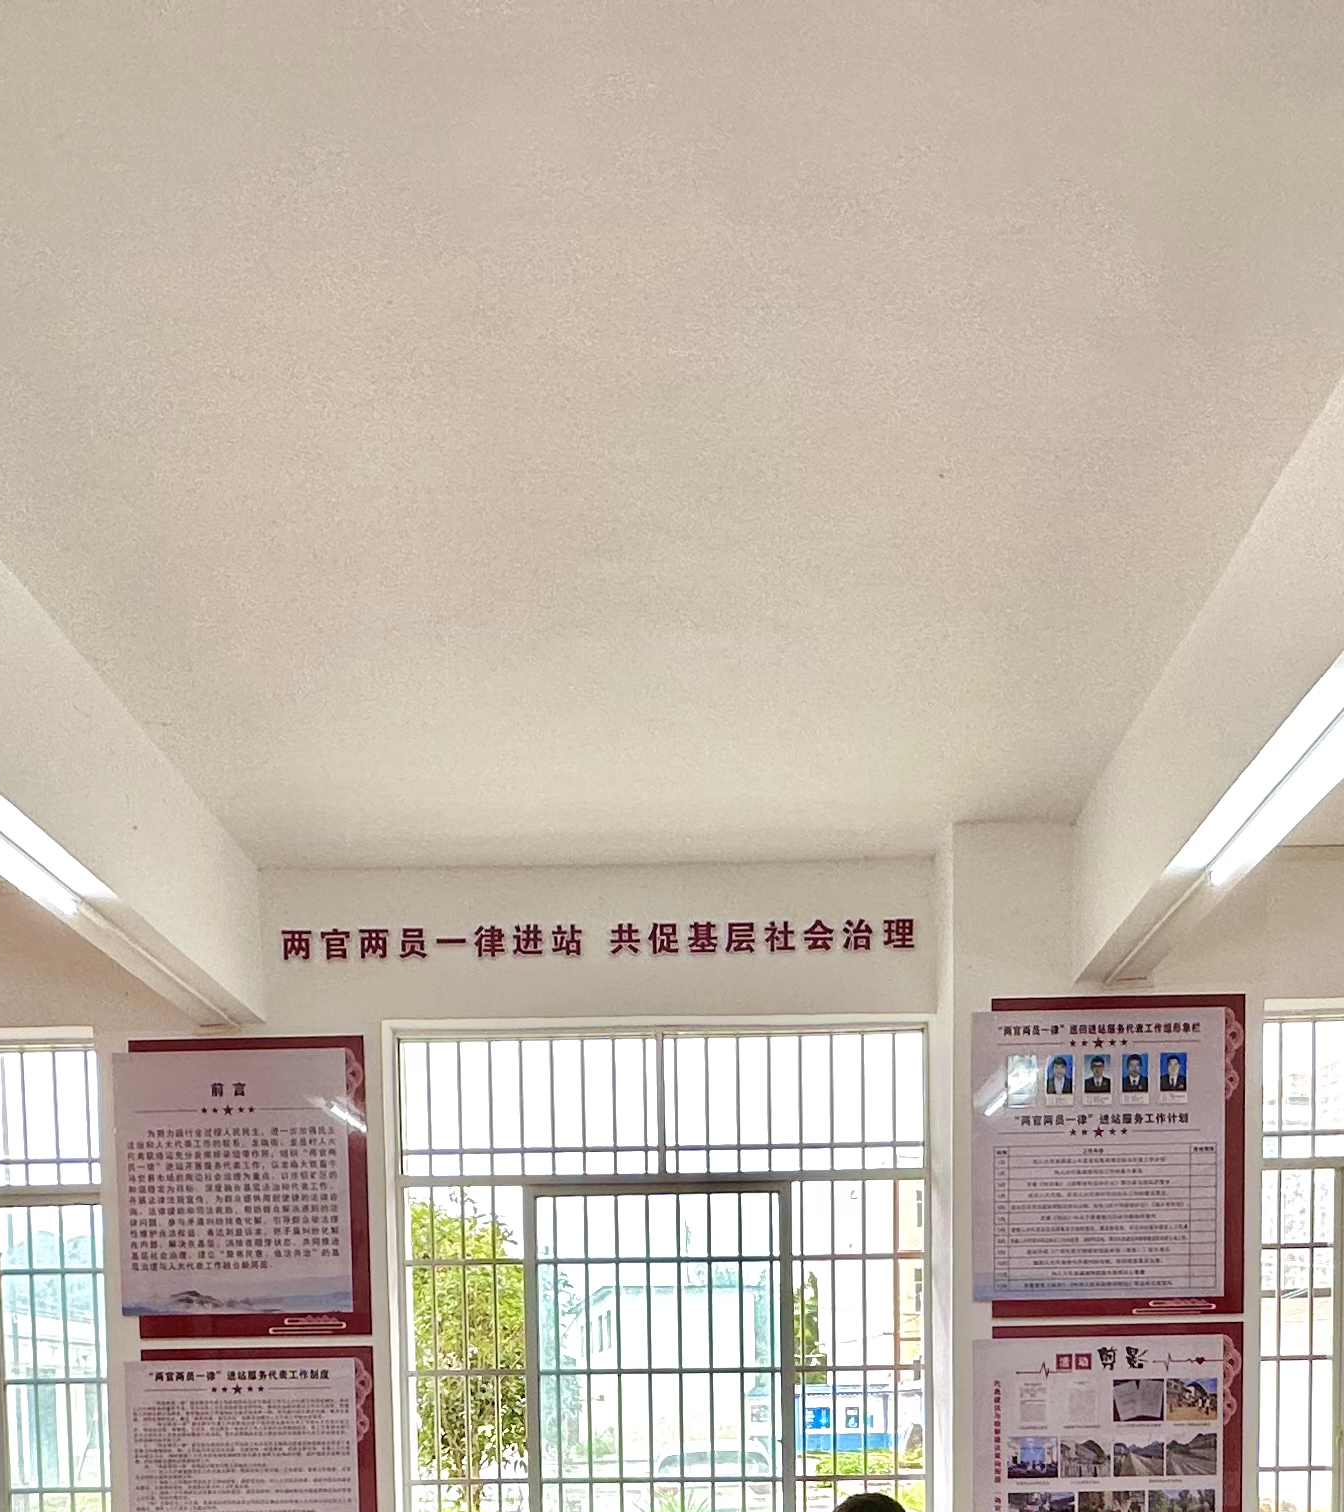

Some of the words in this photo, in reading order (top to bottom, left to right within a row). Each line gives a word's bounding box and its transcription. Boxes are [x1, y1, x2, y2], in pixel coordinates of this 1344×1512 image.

[281, 925, 583, 959] 两官两员一律进站
[609, 918, 916, 957] 共促基层社会治理
